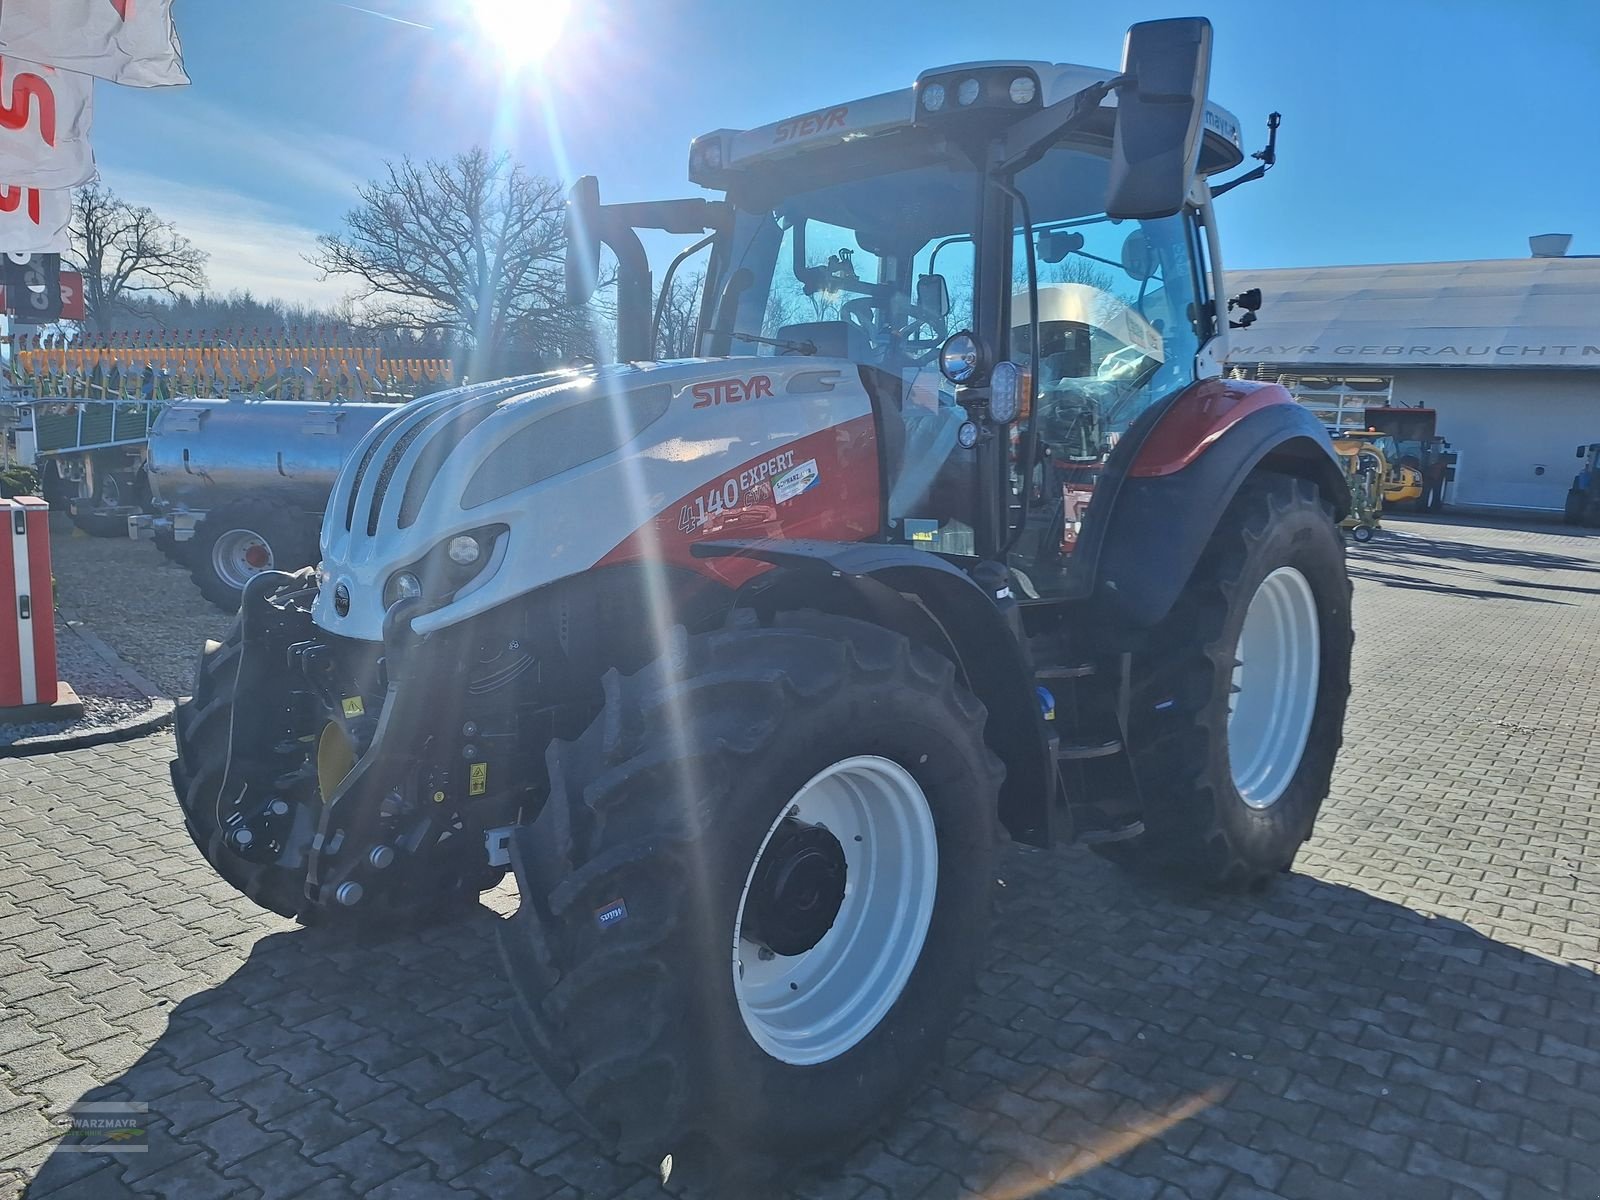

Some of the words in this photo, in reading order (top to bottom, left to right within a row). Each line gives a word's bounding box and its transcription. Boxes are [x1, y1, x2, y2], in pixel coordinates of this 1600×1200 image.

[773, 106, 849, 144] STEYR
[692, 375, 774, 409] STEYR
[740, 450, 794, 490] EXPERT
